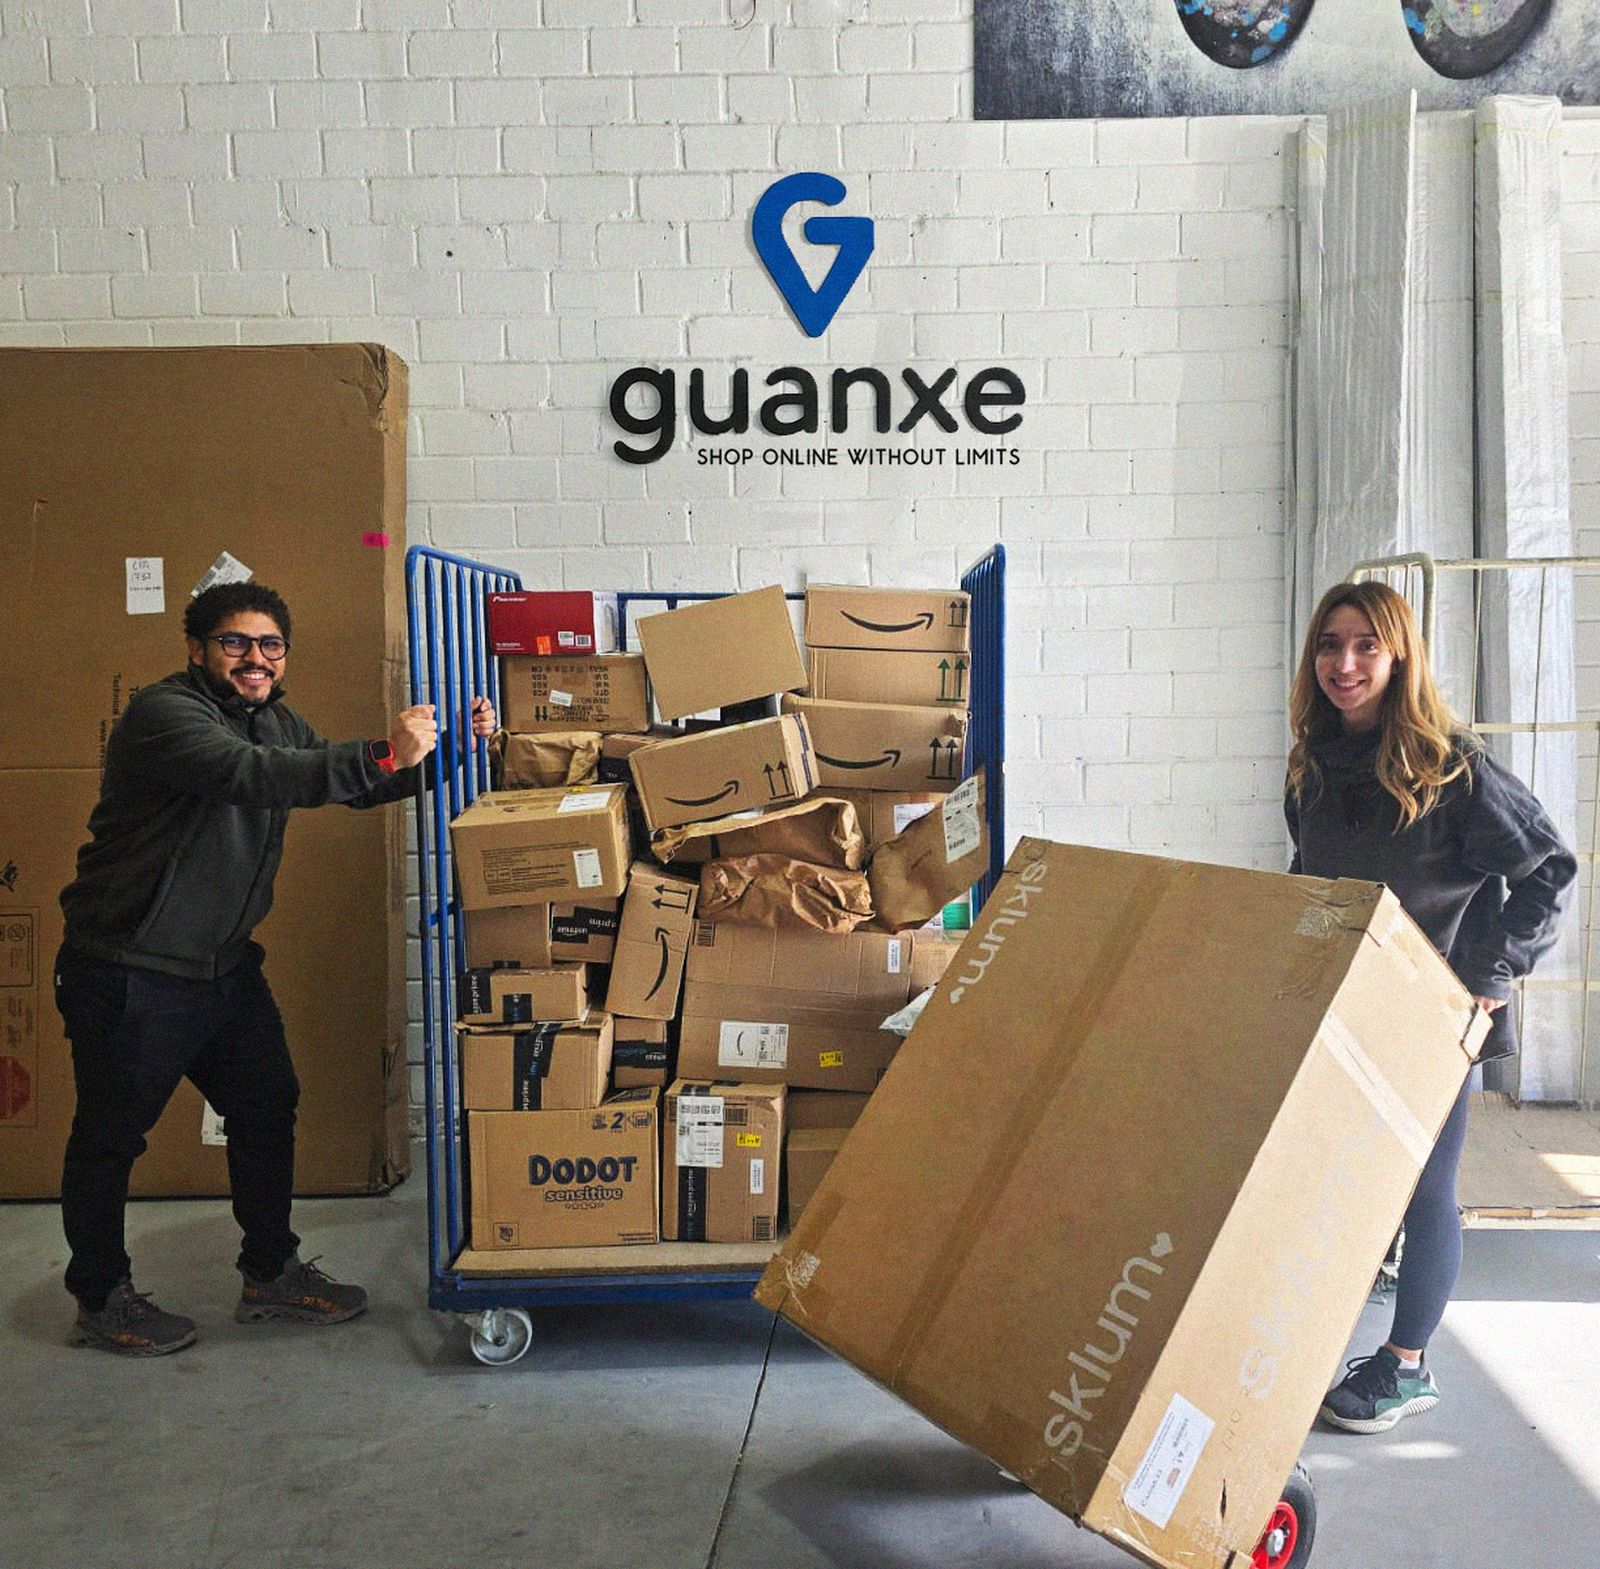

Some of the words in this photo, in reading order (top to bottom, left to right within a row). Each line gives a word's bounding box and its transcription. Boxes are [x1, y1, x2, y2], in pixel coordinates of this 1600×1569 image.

[609, 366, 1026, 465] guanxe
[697, 448, 754, 465] SHOP
[762, 448, 839, 465] ONLINE
[847, 448, 947, 466] WITHOUT
[955, 448, 1021, 466] LIMITS
[958, 859, 1047, 985] sklum
[610, 1111, 626, 1130] 2
[528, 1154, 638, 1186] DODOT
[544, 1185, 624, 1203] sensitive
[1043, 1256, 1166, 1457] sklum
